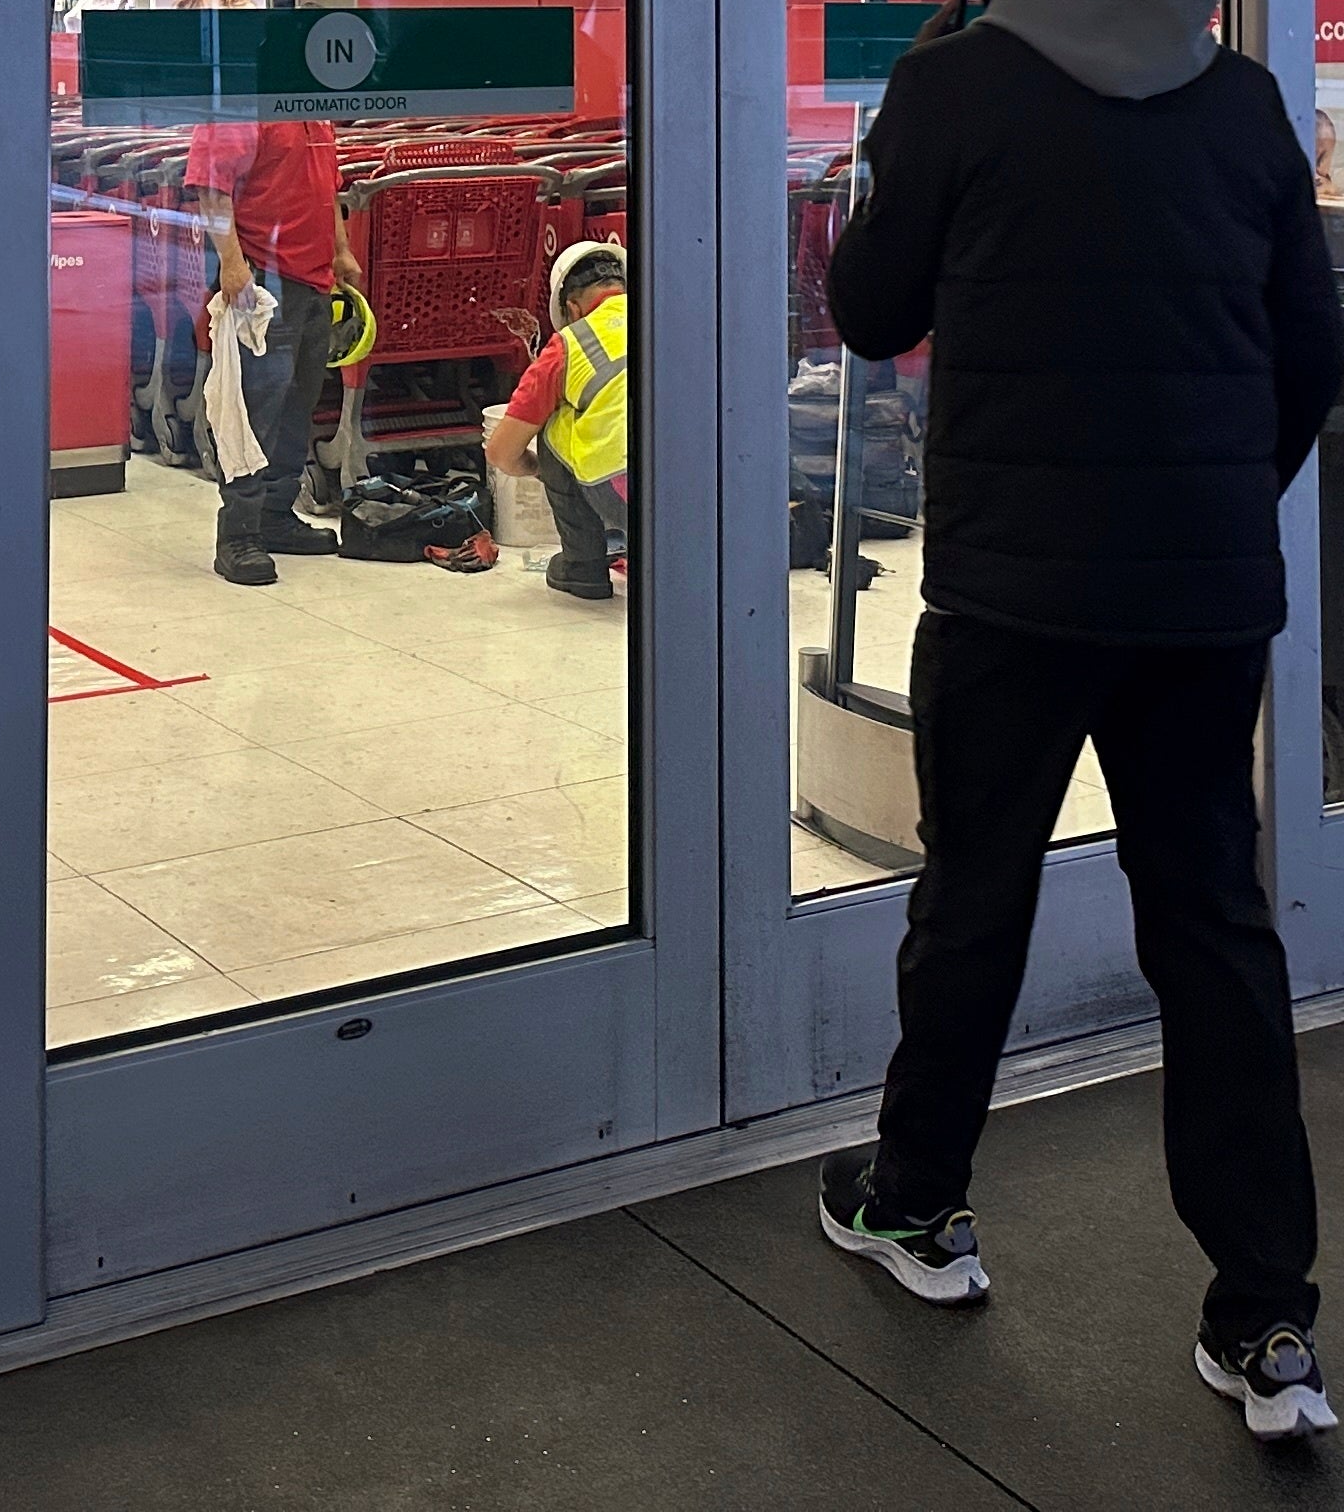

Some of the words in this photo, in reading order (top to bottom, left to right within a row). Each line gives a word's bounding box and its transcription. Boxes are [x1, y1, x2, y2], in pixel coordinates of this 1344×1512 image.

[326, 39, 353, 64] IN
[273, 98, 360, 113] AUTOMATIC
[365, 96, 407, 110] DOOR
